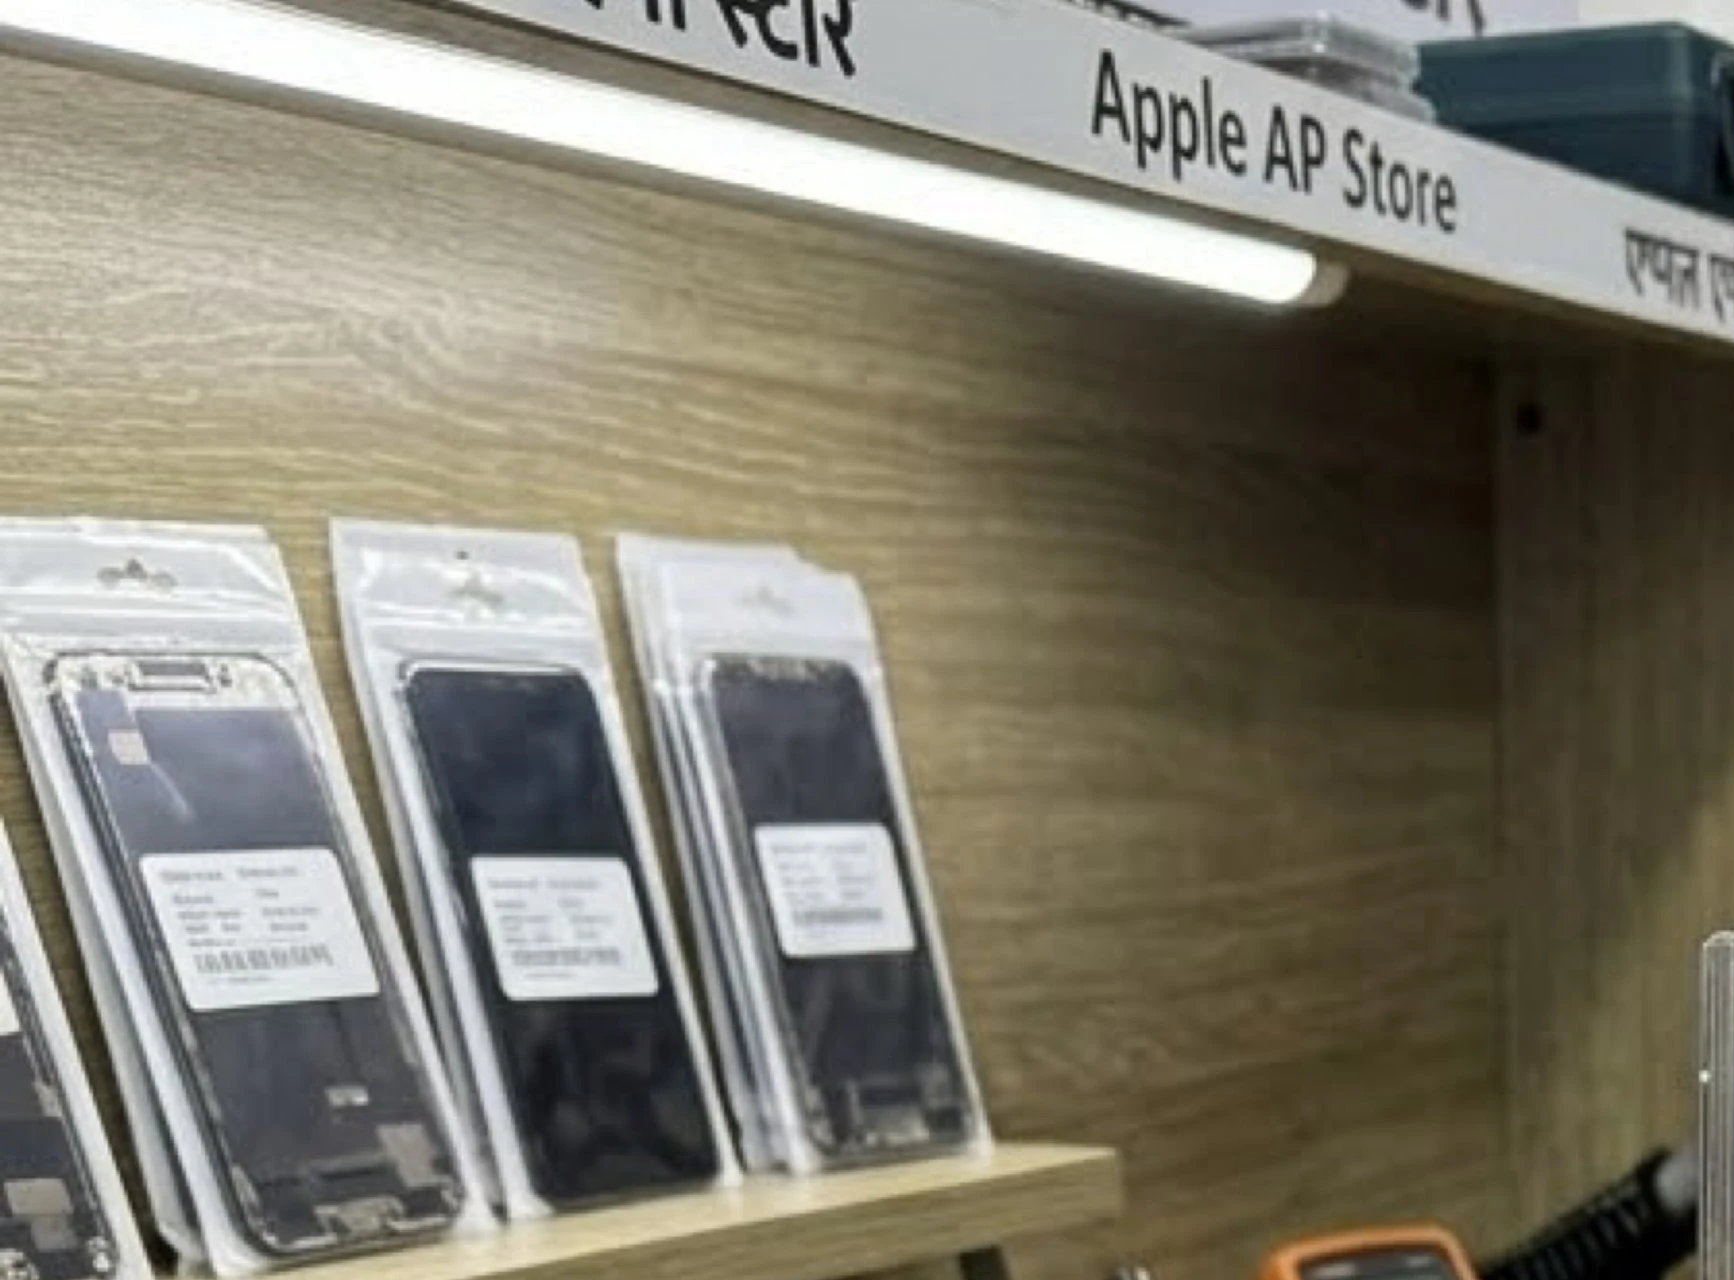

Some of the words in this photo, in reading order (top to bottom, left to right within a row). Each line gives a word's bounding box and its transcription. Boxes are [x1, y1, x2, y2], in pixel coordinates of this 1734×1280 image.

[1091, 49, 1247, 182] Apple
[1264, 105, 1326, 194] AP
[1343, 128, 1457, 234] Store
